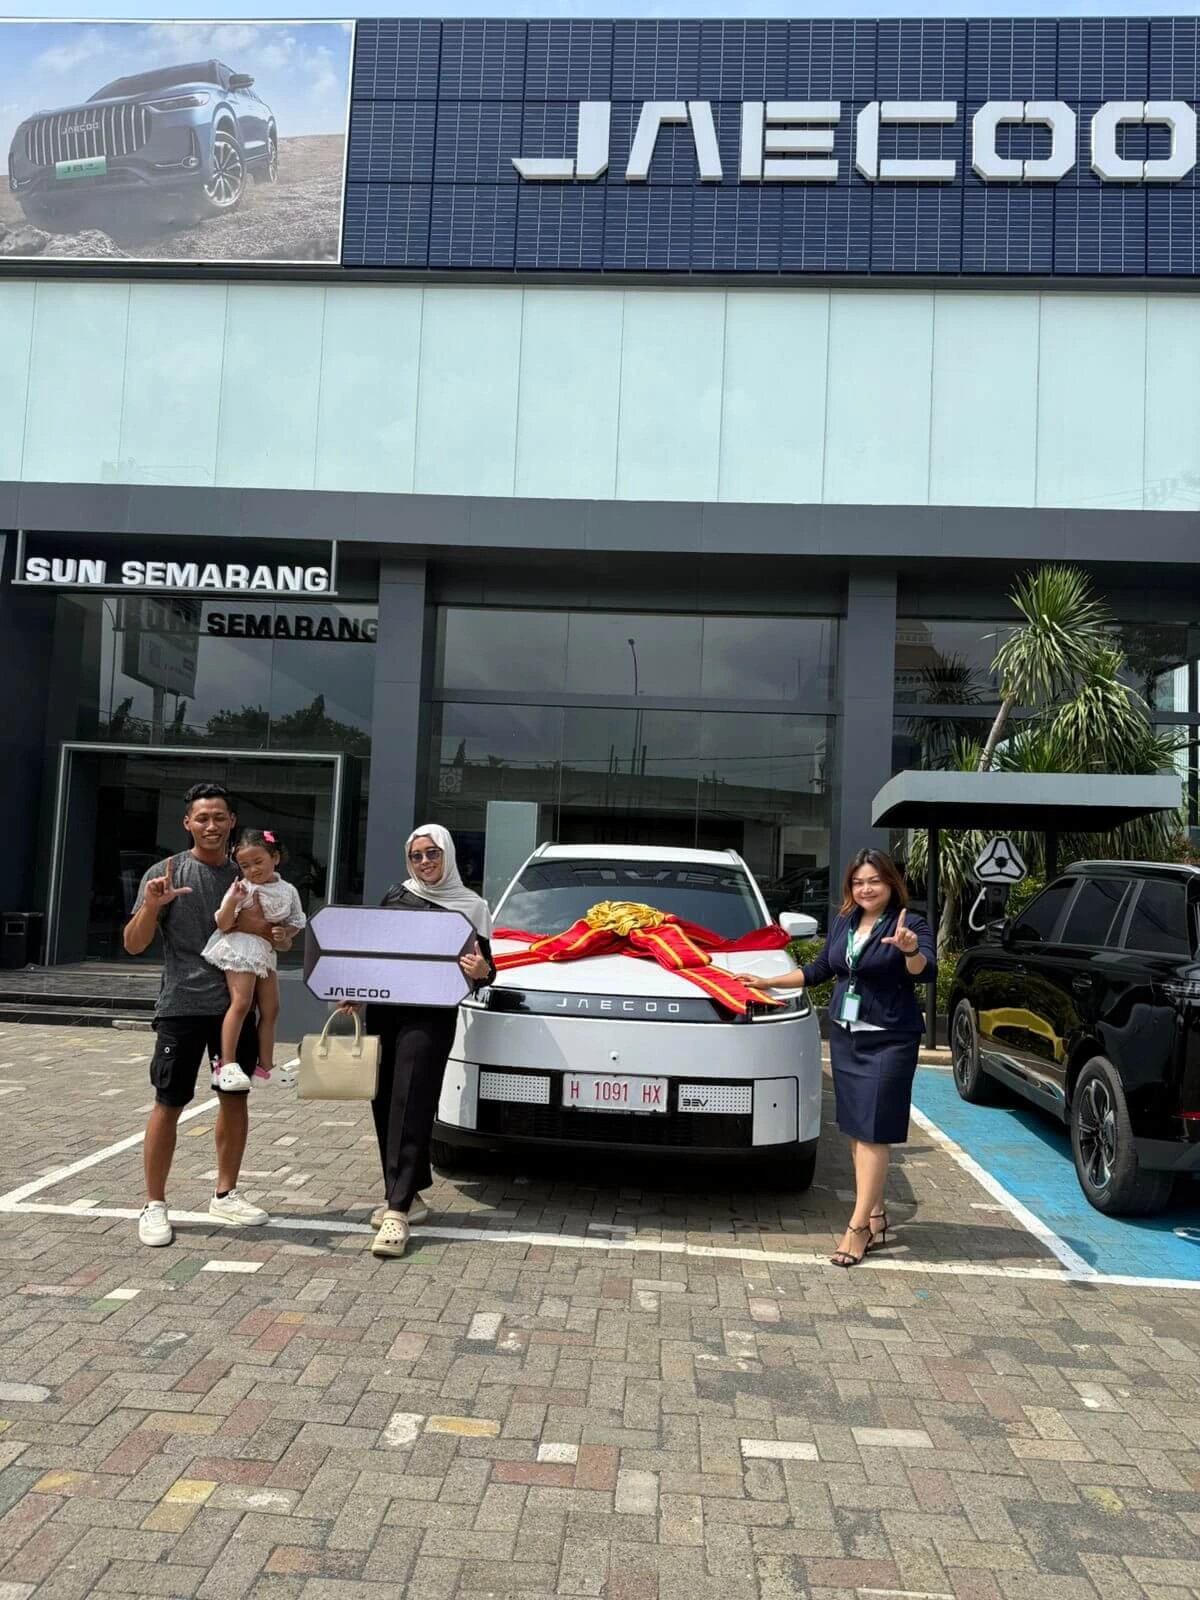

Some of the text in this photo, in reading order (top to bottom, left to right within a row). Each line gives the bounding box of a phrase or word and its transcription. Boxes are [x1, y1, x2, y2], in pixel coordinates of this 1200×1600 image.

[511, 100, 1198, 183] JAECOO
[25, 557, 329, 592] SUN SEMARANG
[207, 612, 378, 642] SEMARANG
[324, 987, 390, 999] JAECOO
[556, 998, 680, 1013] JAECOO
[570, 1080, 661, 1104] H 1091 HX
